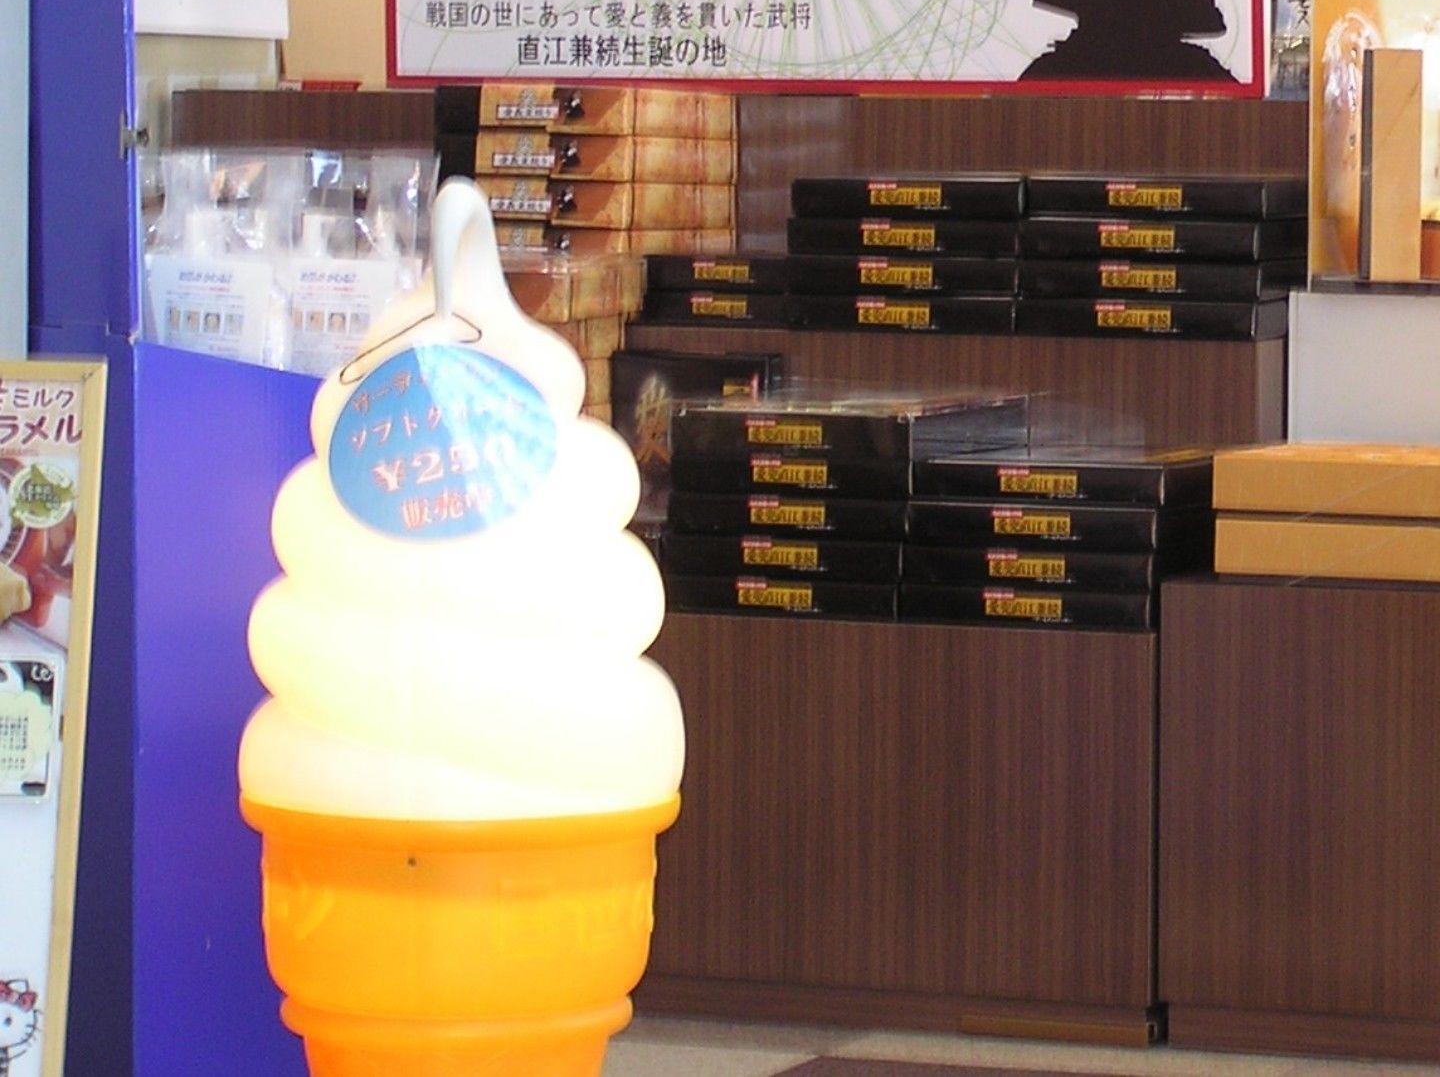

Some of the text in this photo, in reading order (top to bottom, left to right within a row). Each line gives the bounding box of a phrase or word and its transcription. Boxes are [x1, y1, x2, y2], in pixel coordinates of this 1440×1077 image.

[426, 1, 811, 29] 戦国の世にあって愛と義を貫いた武将
[516, 34, 727, 67] 直江兼続生誕の地
[0, 378, 75, 409] ミルク
